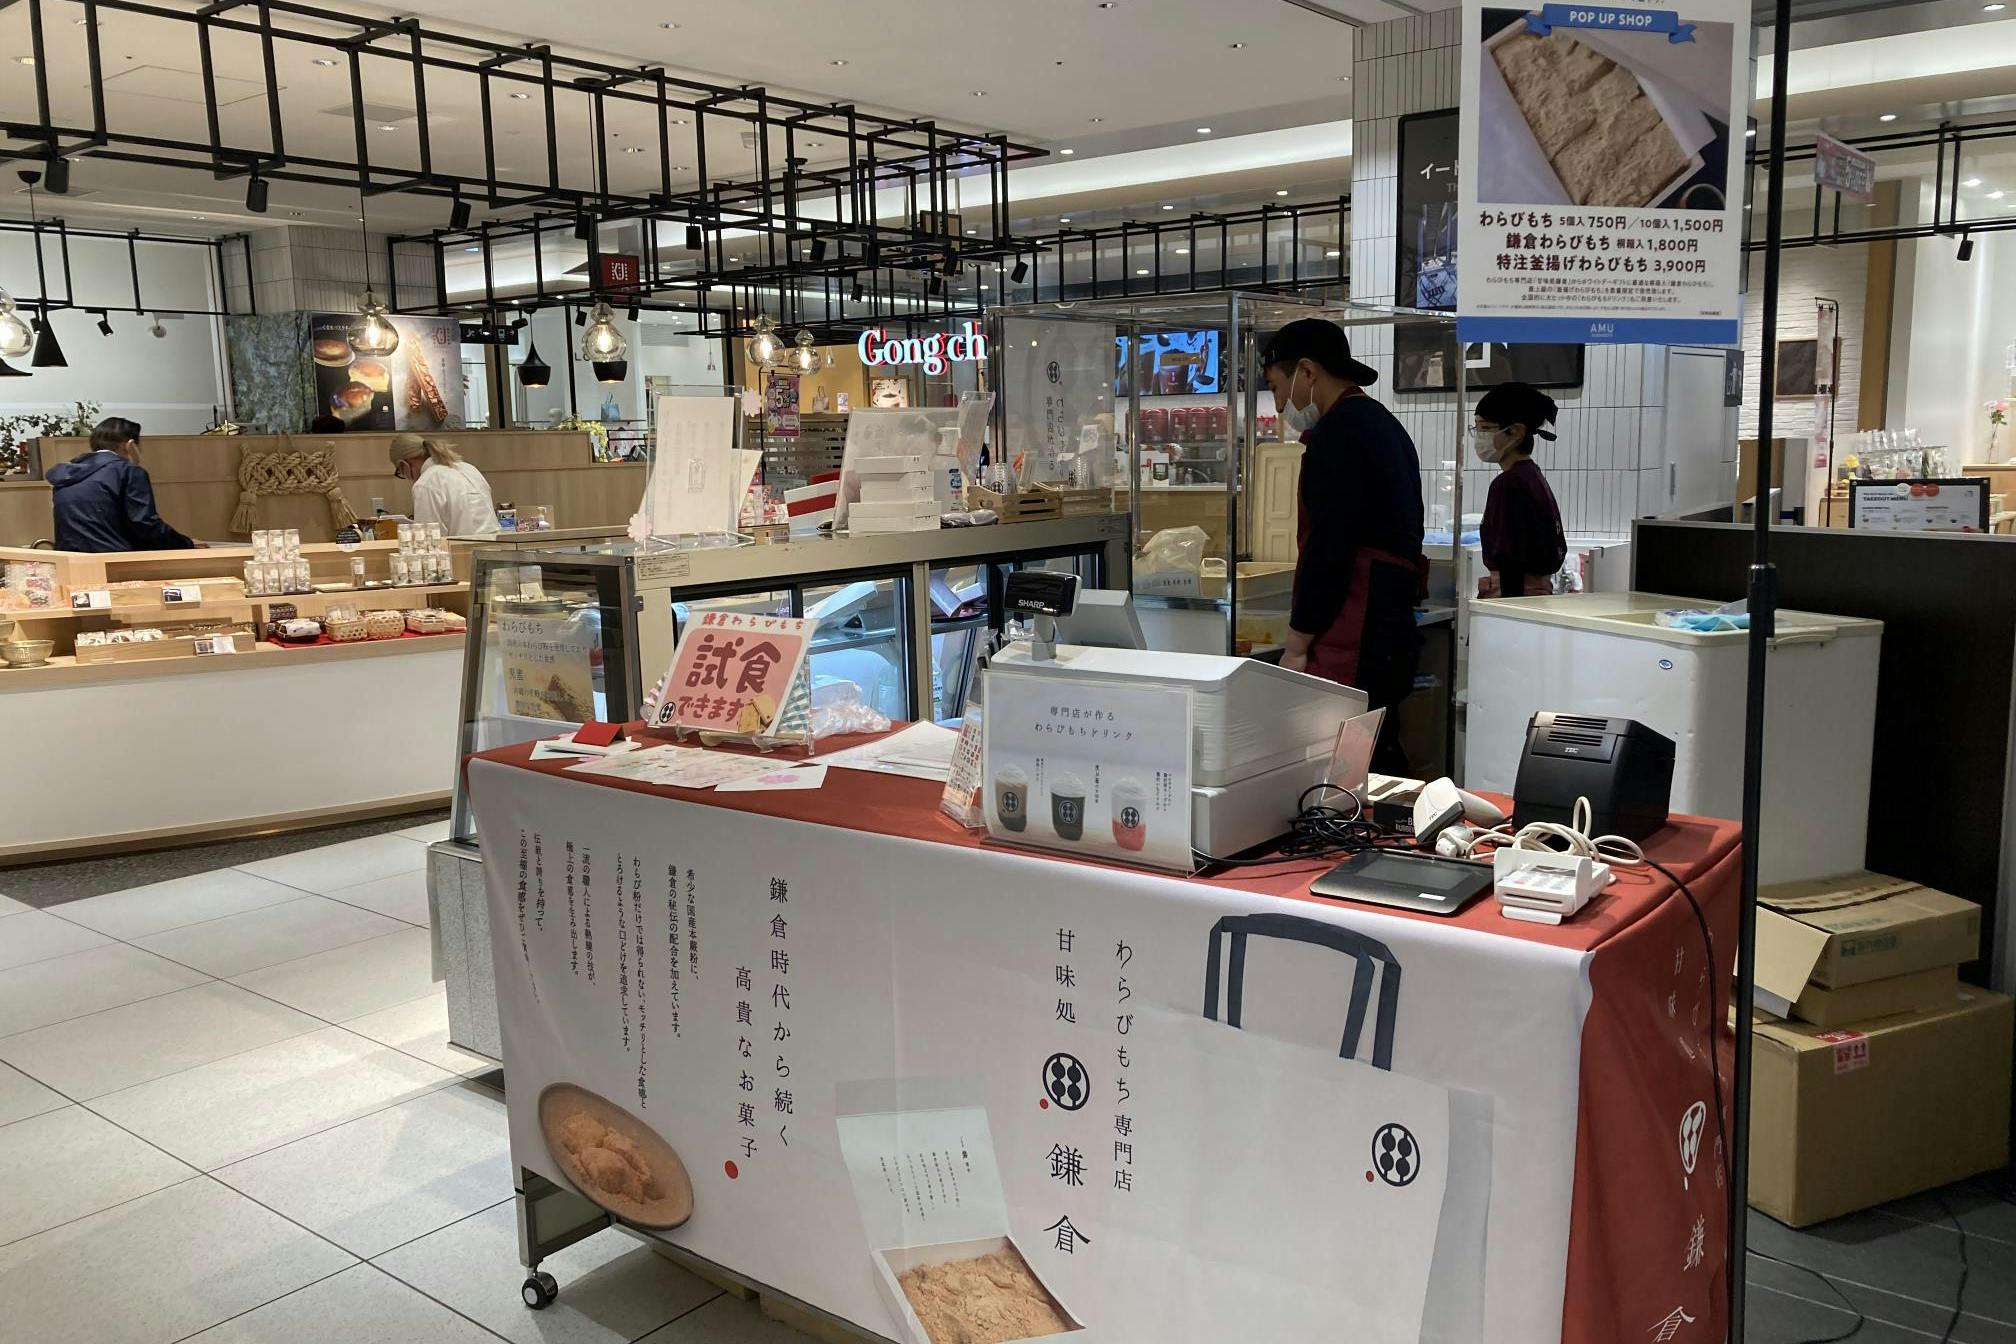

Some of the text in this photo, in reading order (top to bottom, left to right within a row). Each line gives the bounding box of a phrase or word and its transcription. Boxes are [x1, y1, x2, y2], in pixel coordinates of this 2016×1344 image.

[1570, 11, 1652, 27] POP UP SHOP
[1480, 211, 1553, 228] わらびもち
[1560, 216, 1585, 227] 5個入
[1673, 218, 1723, 232] 1,500円
[1506, 232, 1610, 250] 鎌倉わらびもち
[1647, 239, 1698, 252] 1,800円
[1497, 254, 1706, 273] 特注釜揚げわらびもち 3,900円
[1590, 323, 1614, 333] AMU
[858, 320, 988, 375] Gong ch
[1018, 599, 1045, 609] SHARP
[502, 620, 545, 635] わらびもち
[702, 613, 803, 630] 鎌倉わらびもち
[686, 634, 781, 693] 試食
[678, 693, 744, 722] できます
[1050, 706, 1114, 720] 専門店が作る
[1035, 723, 1132, 740] わらびもちドリンク
[769, 876, 793, 1147] 鎌倉時代から続く
[735, 965, 758, 1159] 高貴なお菓子
[1113, 938, 1135, 1192] わらびもち専門店
[1042, 928, 1091, 1254] 甘味処 鎌倉
